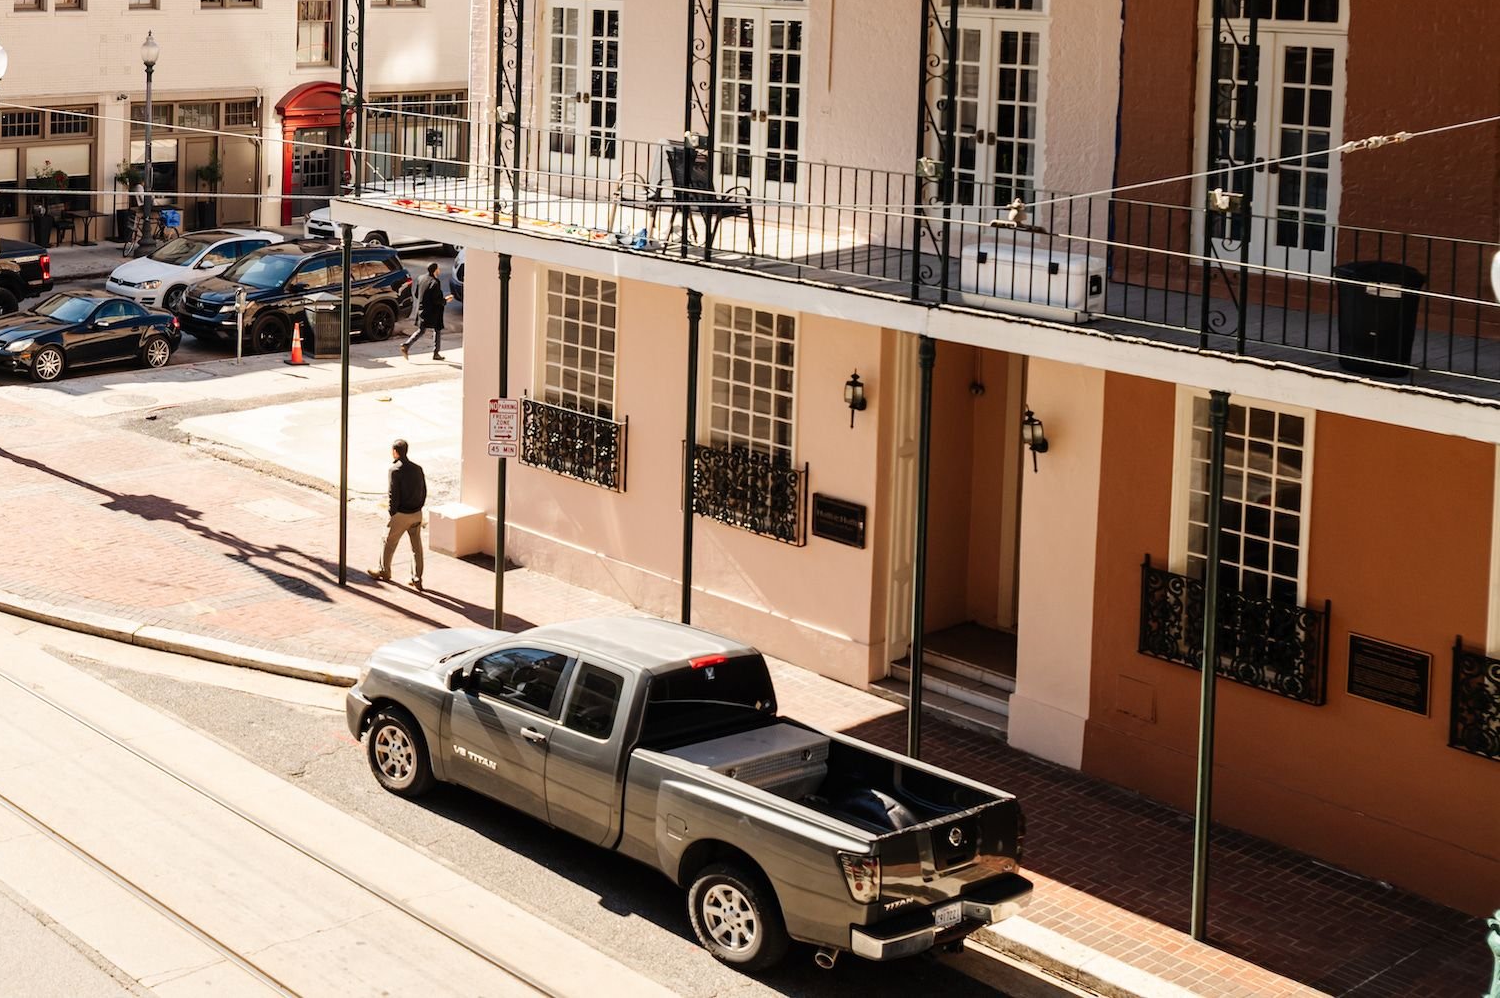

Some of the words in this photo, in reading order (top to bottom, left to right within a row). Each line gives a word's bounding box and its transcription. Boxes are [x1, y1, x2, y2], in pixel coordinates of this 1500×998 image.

[489, 402, 498, 411] NO
[467, 751, 497, 770] TITAN
[884, 897, 913, 911] TITAN
